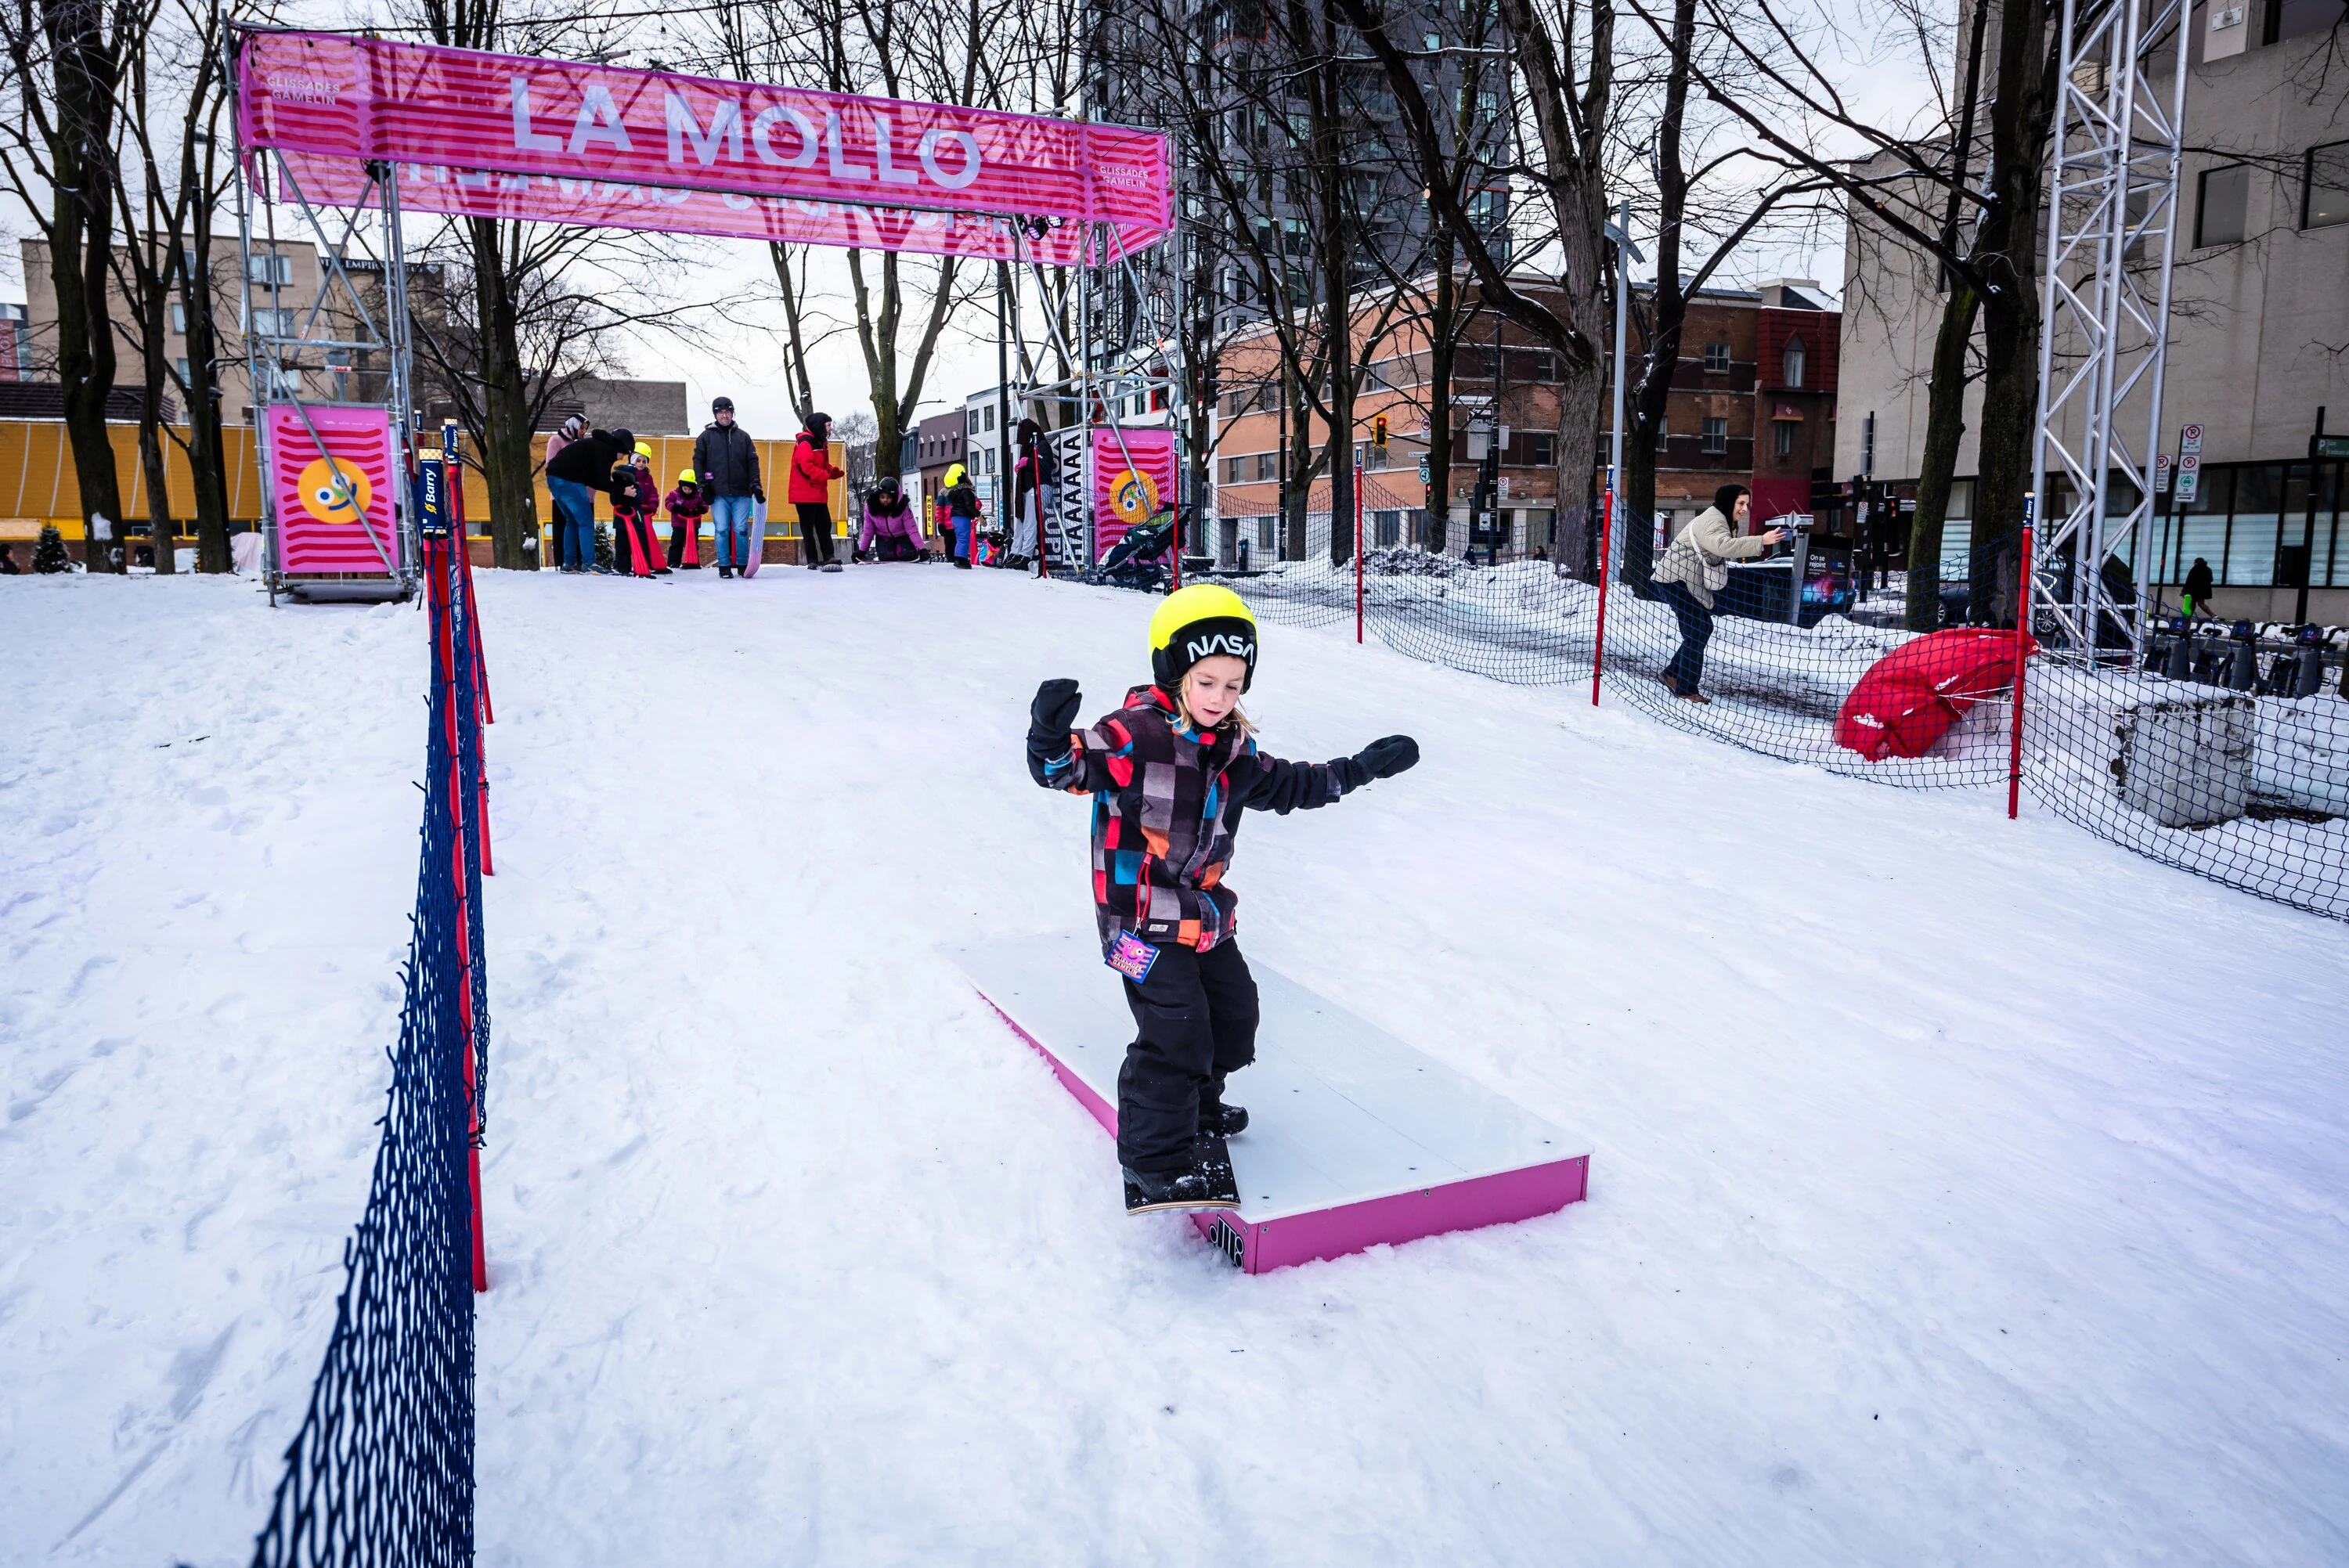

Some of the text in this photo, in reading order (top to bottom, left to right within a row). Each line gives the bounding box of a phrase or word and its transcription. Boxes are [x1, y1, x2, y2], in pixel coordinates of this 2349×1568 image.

[267, 77, 340, 93] GLISSADES
[272, 90, 336, 106] GAMELIN
[511, 77, 981, 189] LA MOLLO
[1100, 166, 1149, 179] GLISSADES
[1103, 176, 1146, 188] GAMELIN
[425, 468, 437, 503] Barry
[1187, 634, 1254, 666] NASA
[1113, 953, 1142, 971] GLISSADES
[1113, 960, 1138, 975] GAMELIN
